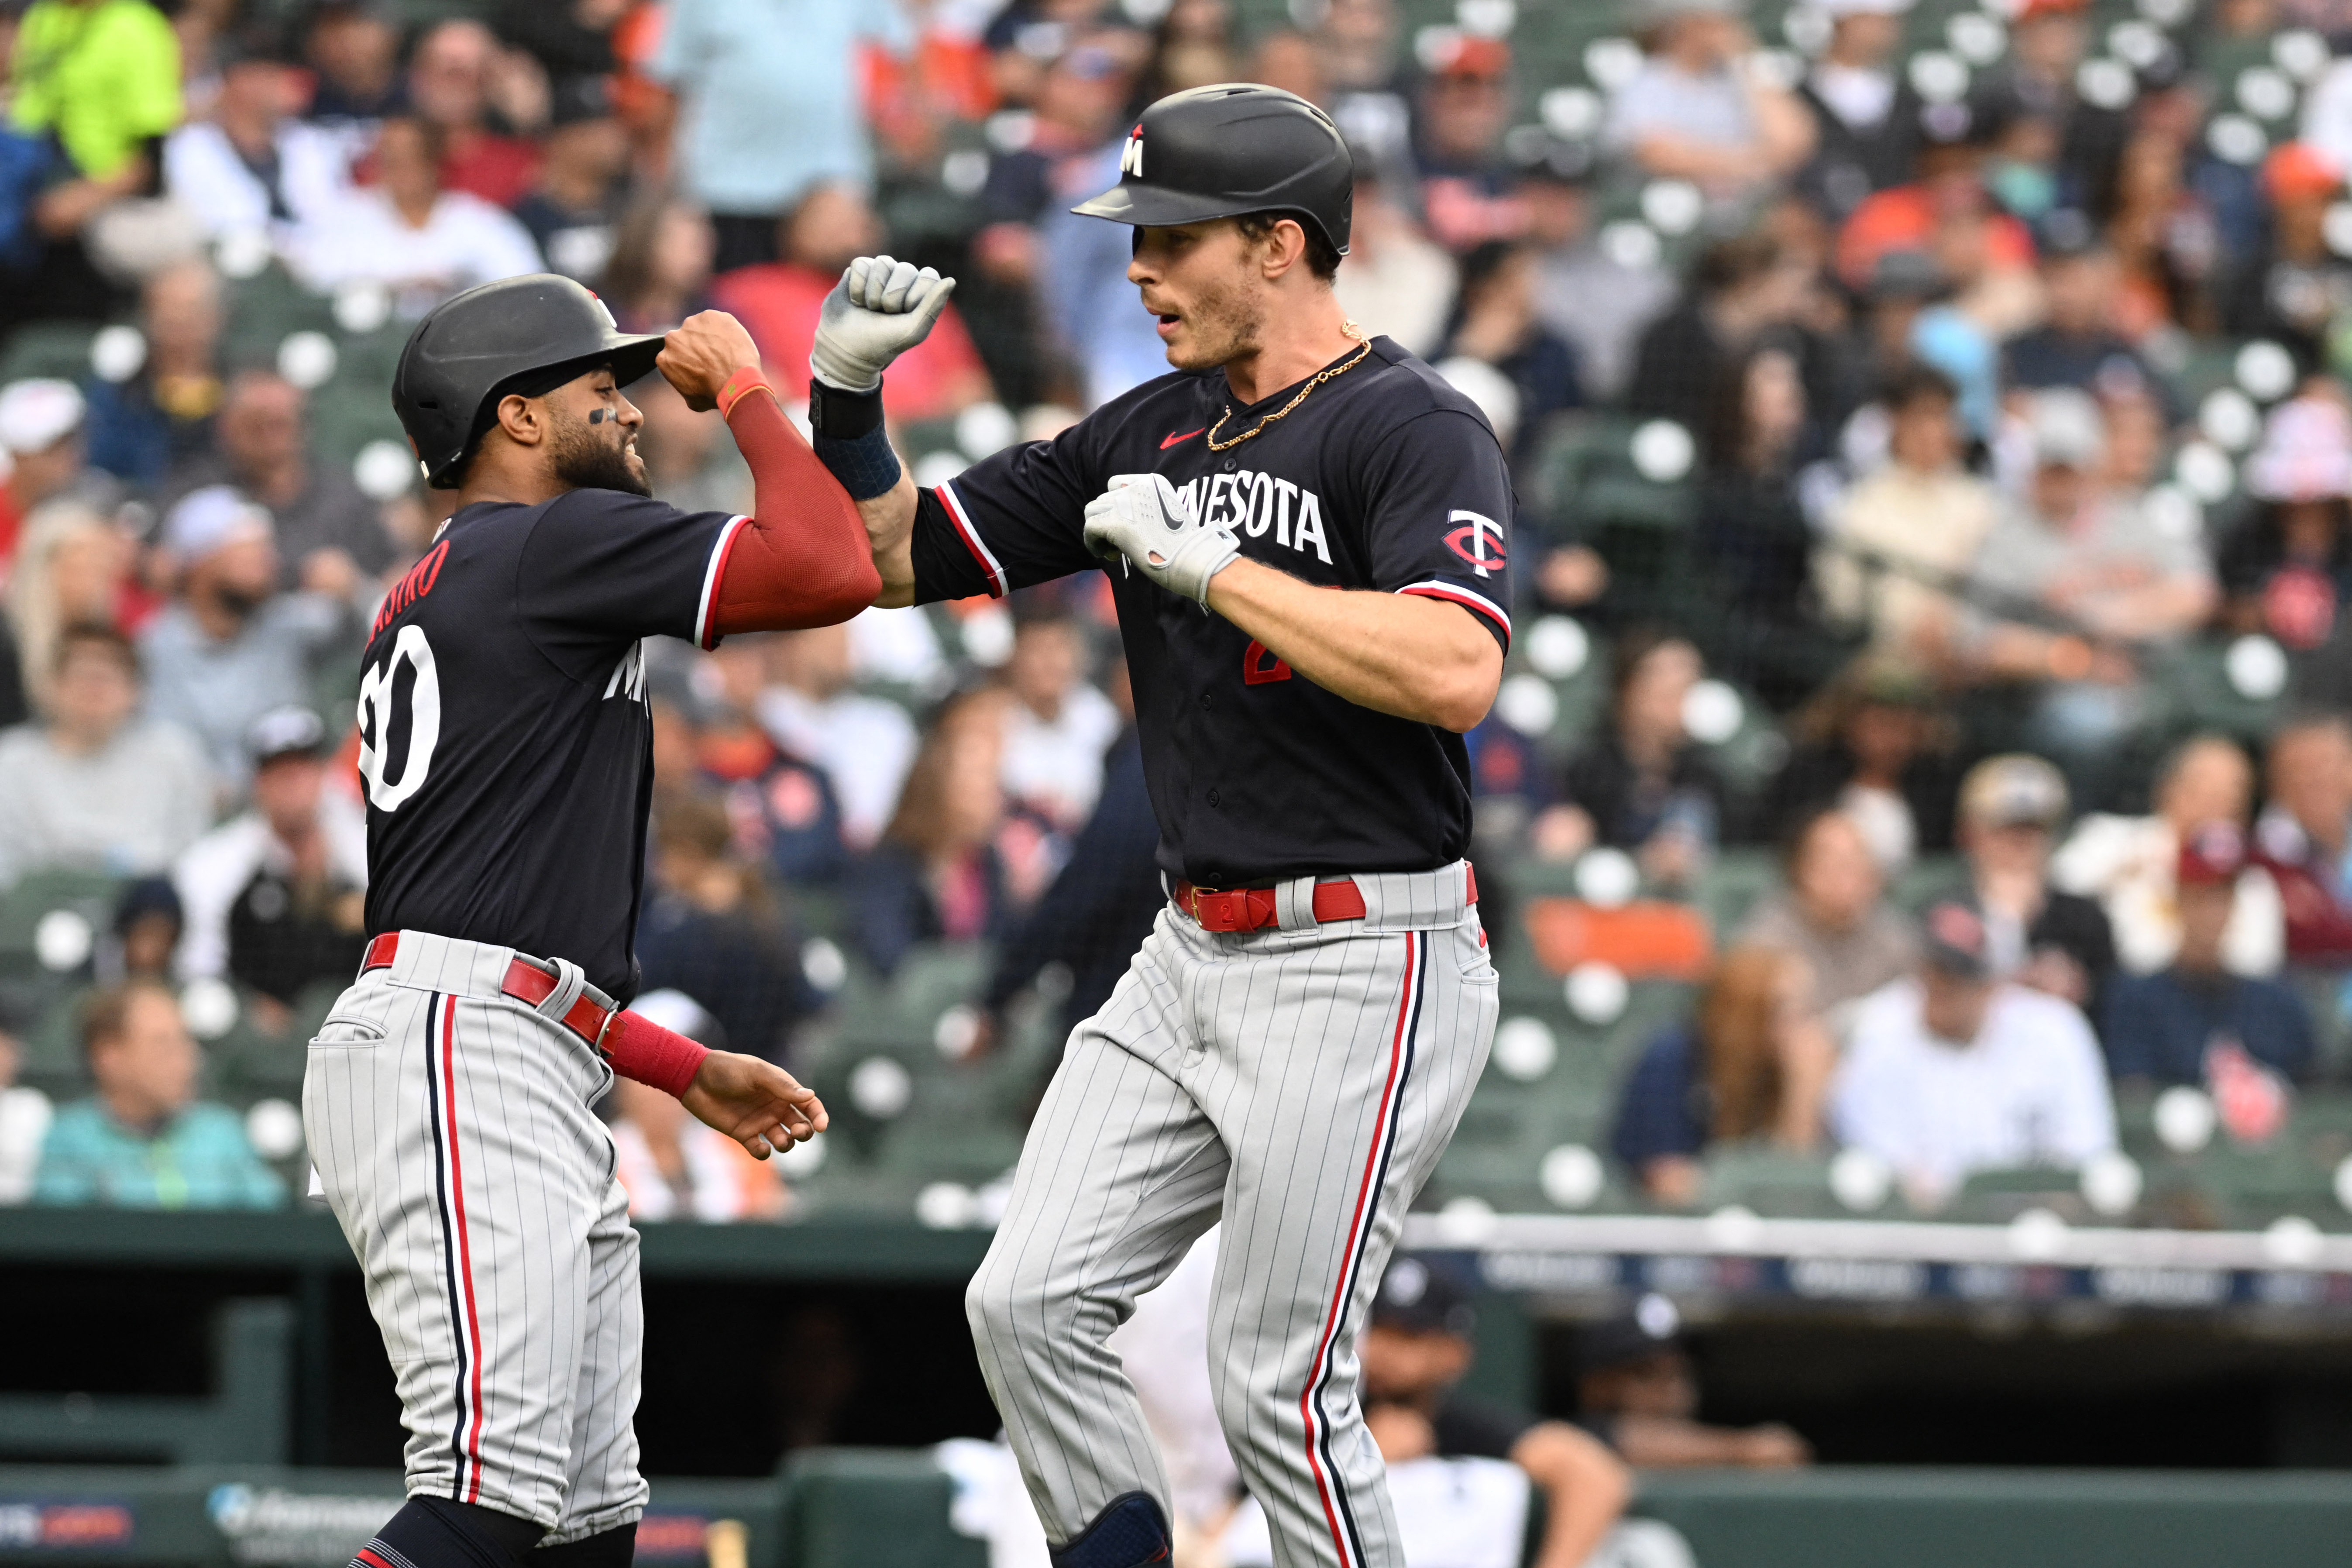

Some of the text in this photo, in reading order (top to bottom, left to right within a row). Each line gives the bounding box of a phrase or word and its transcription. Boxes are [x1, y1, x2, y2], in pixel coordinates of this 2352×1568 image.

[1119, 136, 1143, 177] M
[1121, 470, 1334, 580] NESOTA
[364, 539, 450, 653] ASTRO
